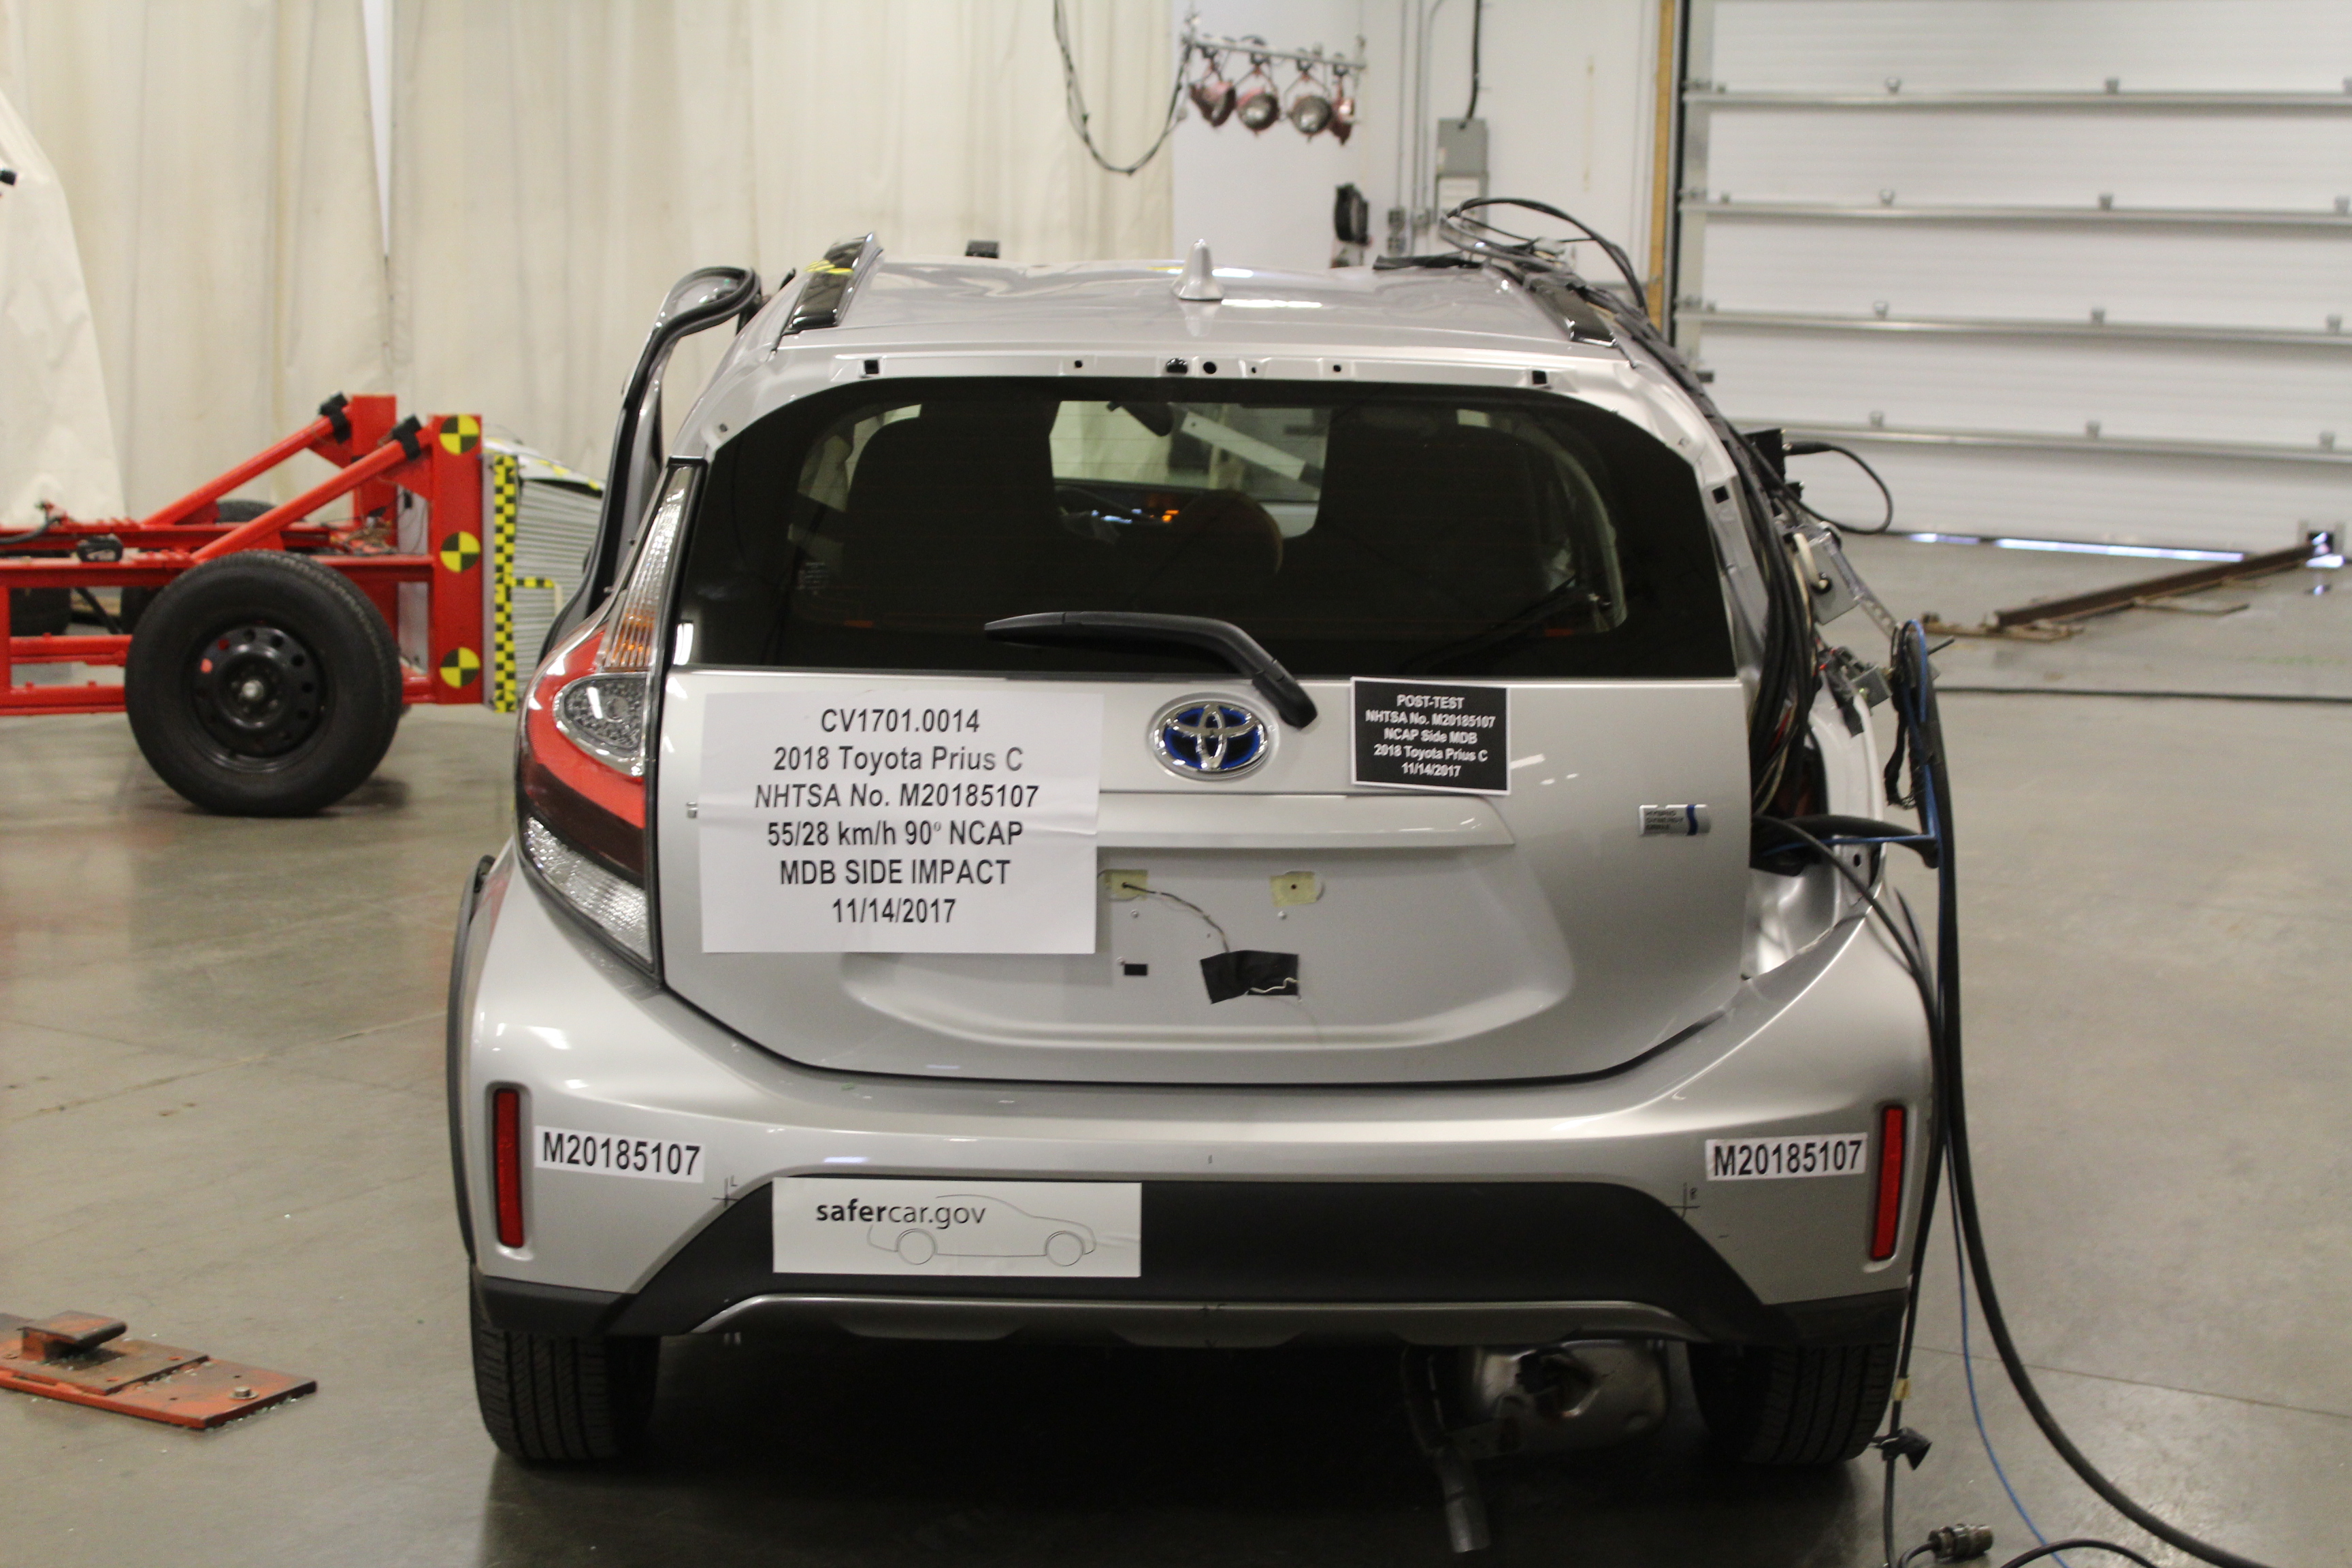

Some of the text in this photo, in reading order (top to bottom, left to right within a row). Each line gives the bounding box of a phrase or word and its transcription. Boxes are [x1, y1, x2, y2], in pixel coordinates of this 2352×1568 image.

[1396, 693, 1465, 710] POST-TEST
[821, 708, 980, 733] CV1701.0014
[1365, 709, 1496, 728] NHTSA No. M20185107
[1384, 727, 1478, 745] NCAP Side MDB
[773, 745, 1023, 777] 2018 Toyota Prius C
[1373, 743, 1488, 762] 2018 Toyota Prius C
[1401, 762, 1462, 777] 11/14/2017
[755, 783, 1039, 808] NHTSA No. M20185107
[768, 821, 829, 847] 55/28
[838, 820, 896, 845] km/h
[950, 820, 1023, 845] NCAP
[781, 859, 1011, 885] MDB SIDE IMPACT
[832, 898, 956, 924] 11/14/2017
[544, 1131, 700, 1175] M20185107
[1714, 1139, 1863, 1177] M20185107
[816, 1198, 987, 1229] safercar.gov
